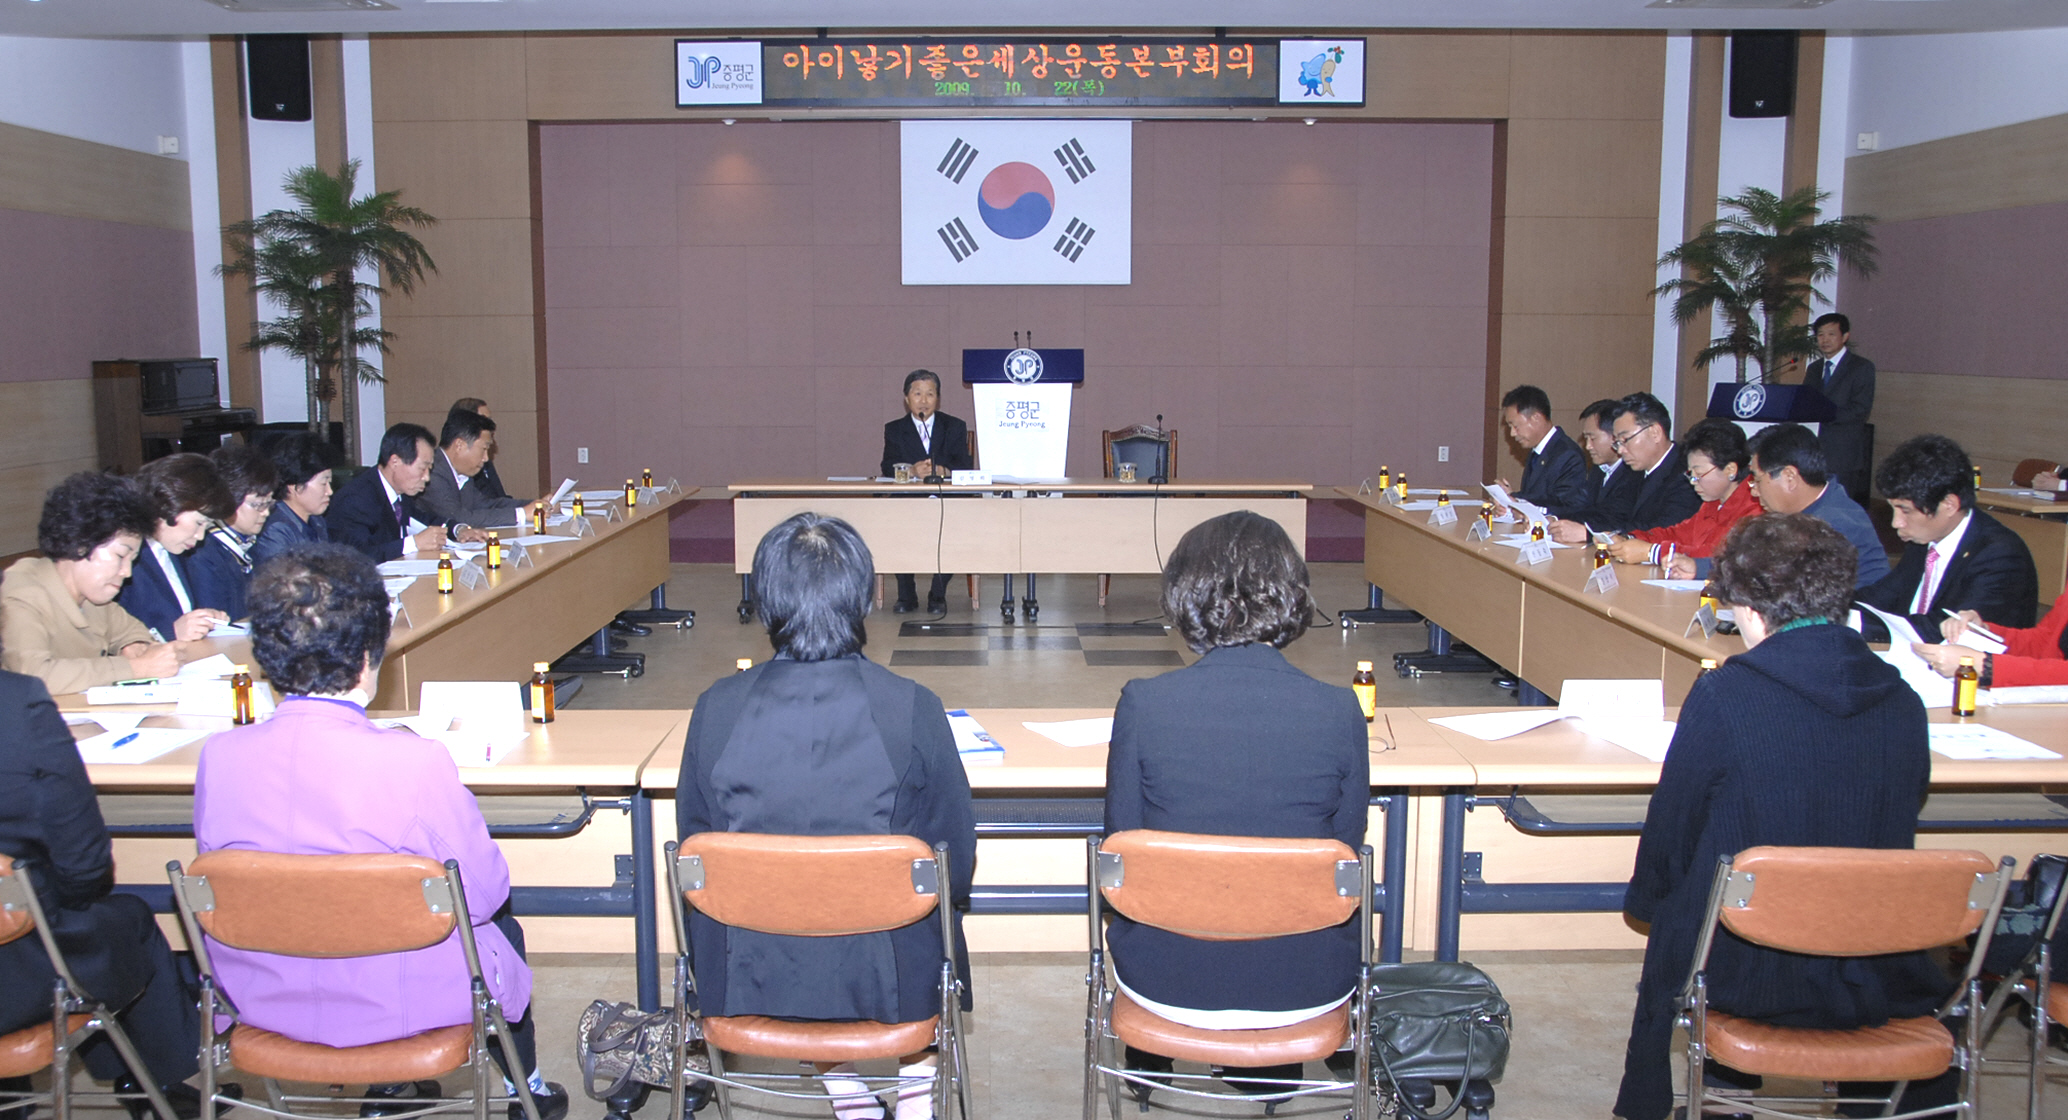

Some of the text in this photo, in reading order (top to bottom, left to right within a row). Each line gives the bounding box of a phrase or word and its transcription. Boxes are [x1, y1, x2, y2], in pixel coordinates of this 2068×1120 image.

[723, 64, 754, 82] 증평군
[711, 82, 754, 91] Jeung Pyeong
[1005, 401, 1040, 420] 증평군
[999, 420, 1046, 429] Jeung Pyeong
